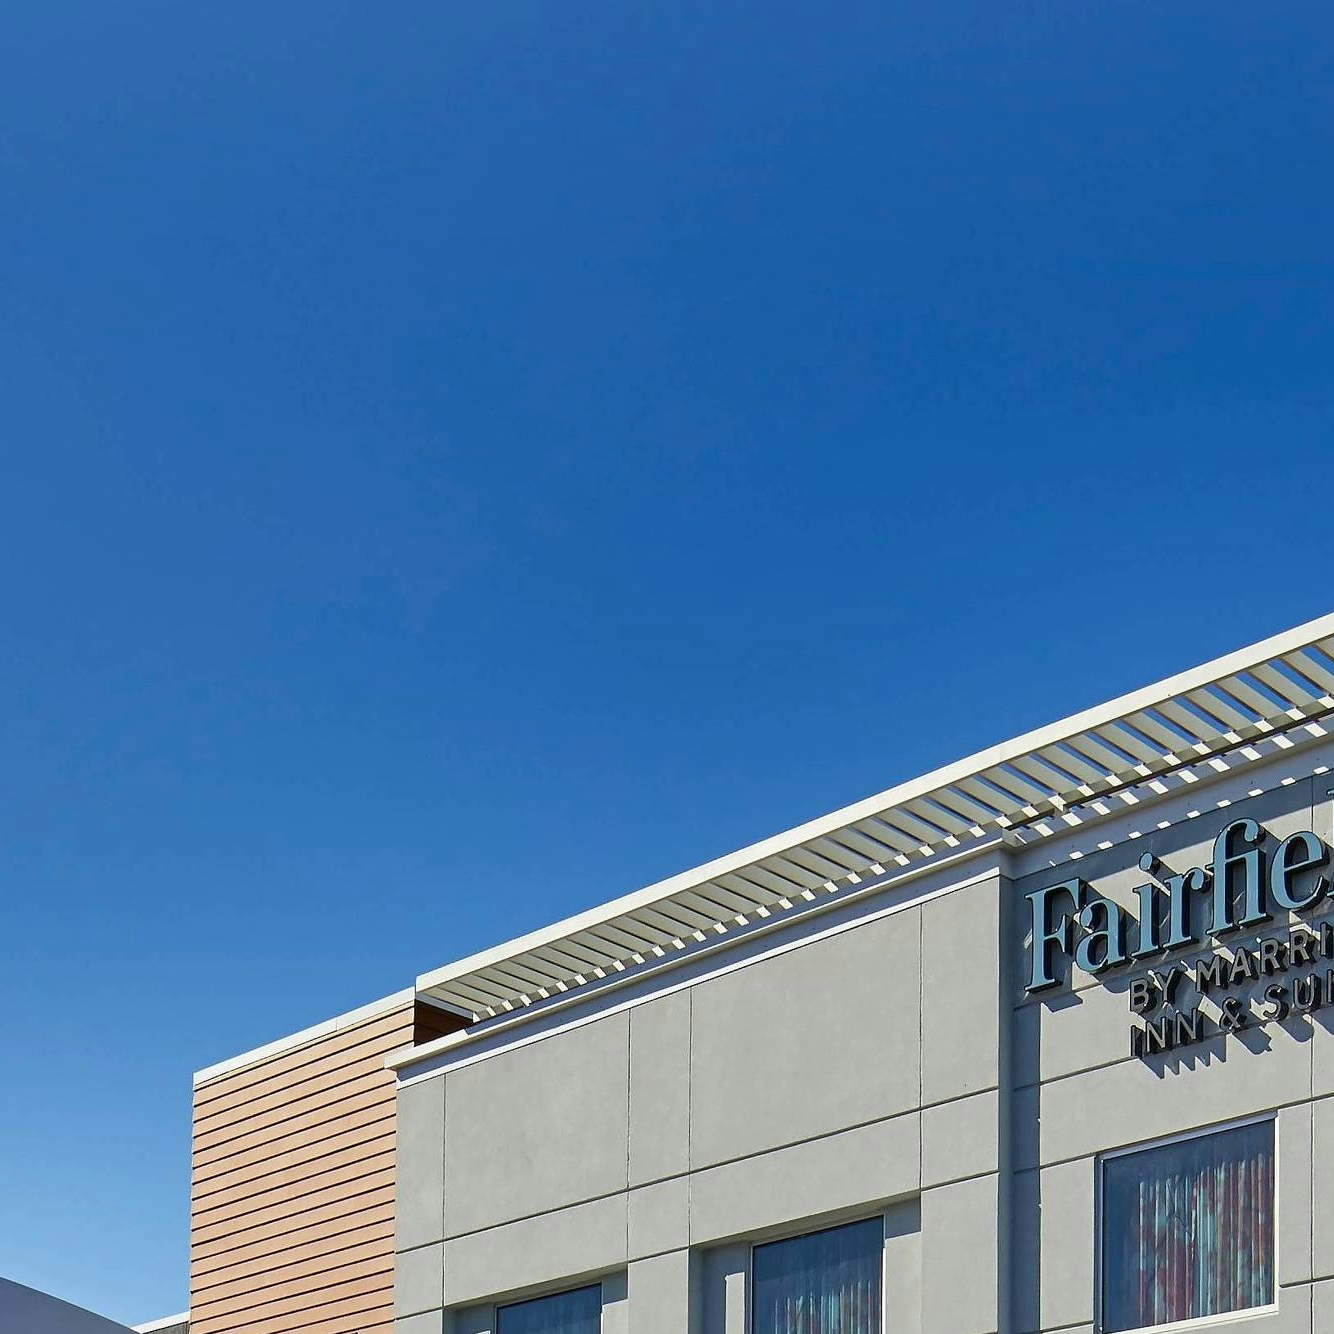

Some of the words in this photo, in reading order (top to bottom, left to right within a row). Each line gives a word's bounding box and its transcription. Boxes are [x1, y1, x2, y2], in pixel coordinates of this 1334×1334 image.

[1129, 967, 1183, 1013] BY
[1130, 1008, 1204, 1058] INN
[1218, 997, 1247, 1034] &
